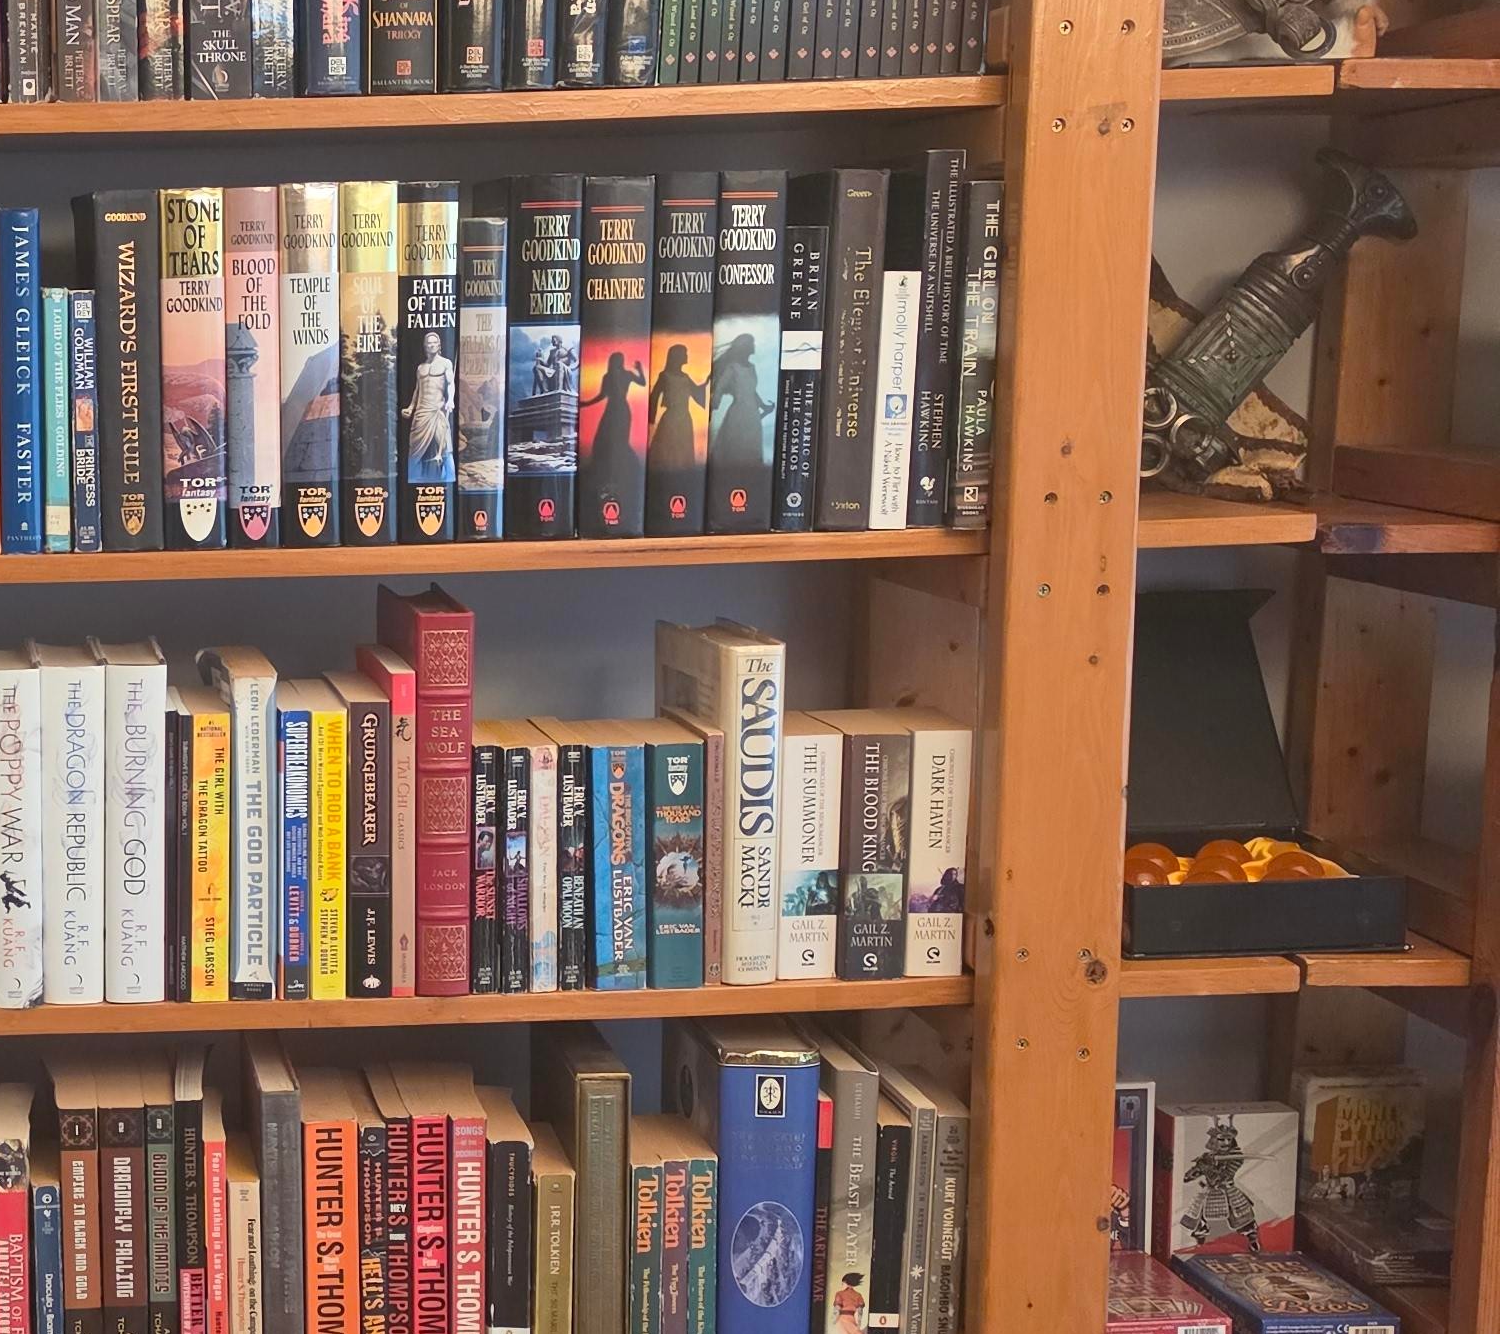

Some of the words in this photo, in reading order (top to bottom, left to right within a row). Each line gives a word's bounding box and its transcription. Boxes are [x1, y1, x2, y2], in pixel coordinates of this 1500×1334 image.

[203, 40, 238, 51] SKULL
[168, 199, 220, 223] STONE
[184, 226, 205, 248] OF
[534, 215, 570, 237] TERRY
[732, 205, 766, 227] TERRY
[984, 200, 1000, 237] THE
[13, 227, 29, 297] JAMES
[169, 251, 219, 276] TEARS
[290, 278, 330, 293] TEMPLE
[413, 279, 452, 295] FAITH
[532, 269, 570, 291] NAKED
[719, 264, 774, 285] CONFESSOR
[790, 243, 804, 319] GREENE
[967, 268, 982, 306] THE
[982, 245, 997, 289] GIRL
[117, 241, 136, 354] WIZARD'S
[587, 279, 645, 300] CHAINFIRE
[982, 297, 996, 324] ON
[15, 308, 30, 395] GLEICK
[963, 314, 978, 376] TRAIN
[121, 361, 138, 421] FIRST
[17, 423, 32, 504] FASTER
[121, 427, 140, 484] RULE
[2, 687, 16, 713] THE
[68, 681, 81, 709] THE
[128, 681, 143, 719] THE
[1, 720, 22, 801] POPPY
[66, 713, 86, 804] DRAGON
[125, 726, 146, 827] BURNING
[285, 721, 308, 819] SUPERFREAKONOMICS
[360, 713, 377, 845] GRUDGEBEARER
[739, 678, 776, 838] SAUDIS
[931, 755, 945, 793] DARK
[246, 780, 262, 819] THE
[929, 799, 943, 849] HAVEN
[1, 810, 22, 864] WAR
[66, 813, 86, 901] REPUBLIC
[246, 825, 263, 863] GOD
[123, 840, 146, 895] GOD
[247, 869, 264, 966] PARTICLE
[851, 936, 892, 948] MARTIN
[113, 1157, 132, 1232] DRAGONFLY
[315, 1128, 342, 1226] HUNTER
[417, 1123, 444, 1219] HUNTER
[849, 1163, 863, 1207] BEAST
[456, 1162, 481, 1244] HUNTER
[637, 1175, 659, 1253] Tolkien
[664, 1170, 686, 1248] Tolkien
[691, 1170, 713, 1249] Tolkien
[316, 1237, 344, 1263] S.
[417, 1232, 445, 1259] S.
[456, 1249, 481, 1270] S.
[846, 1212, 861, 1266] PLAYER
[115, 1239, 134, 1298] FALLING
[361, 1258, 384, 1311] HELL'S
